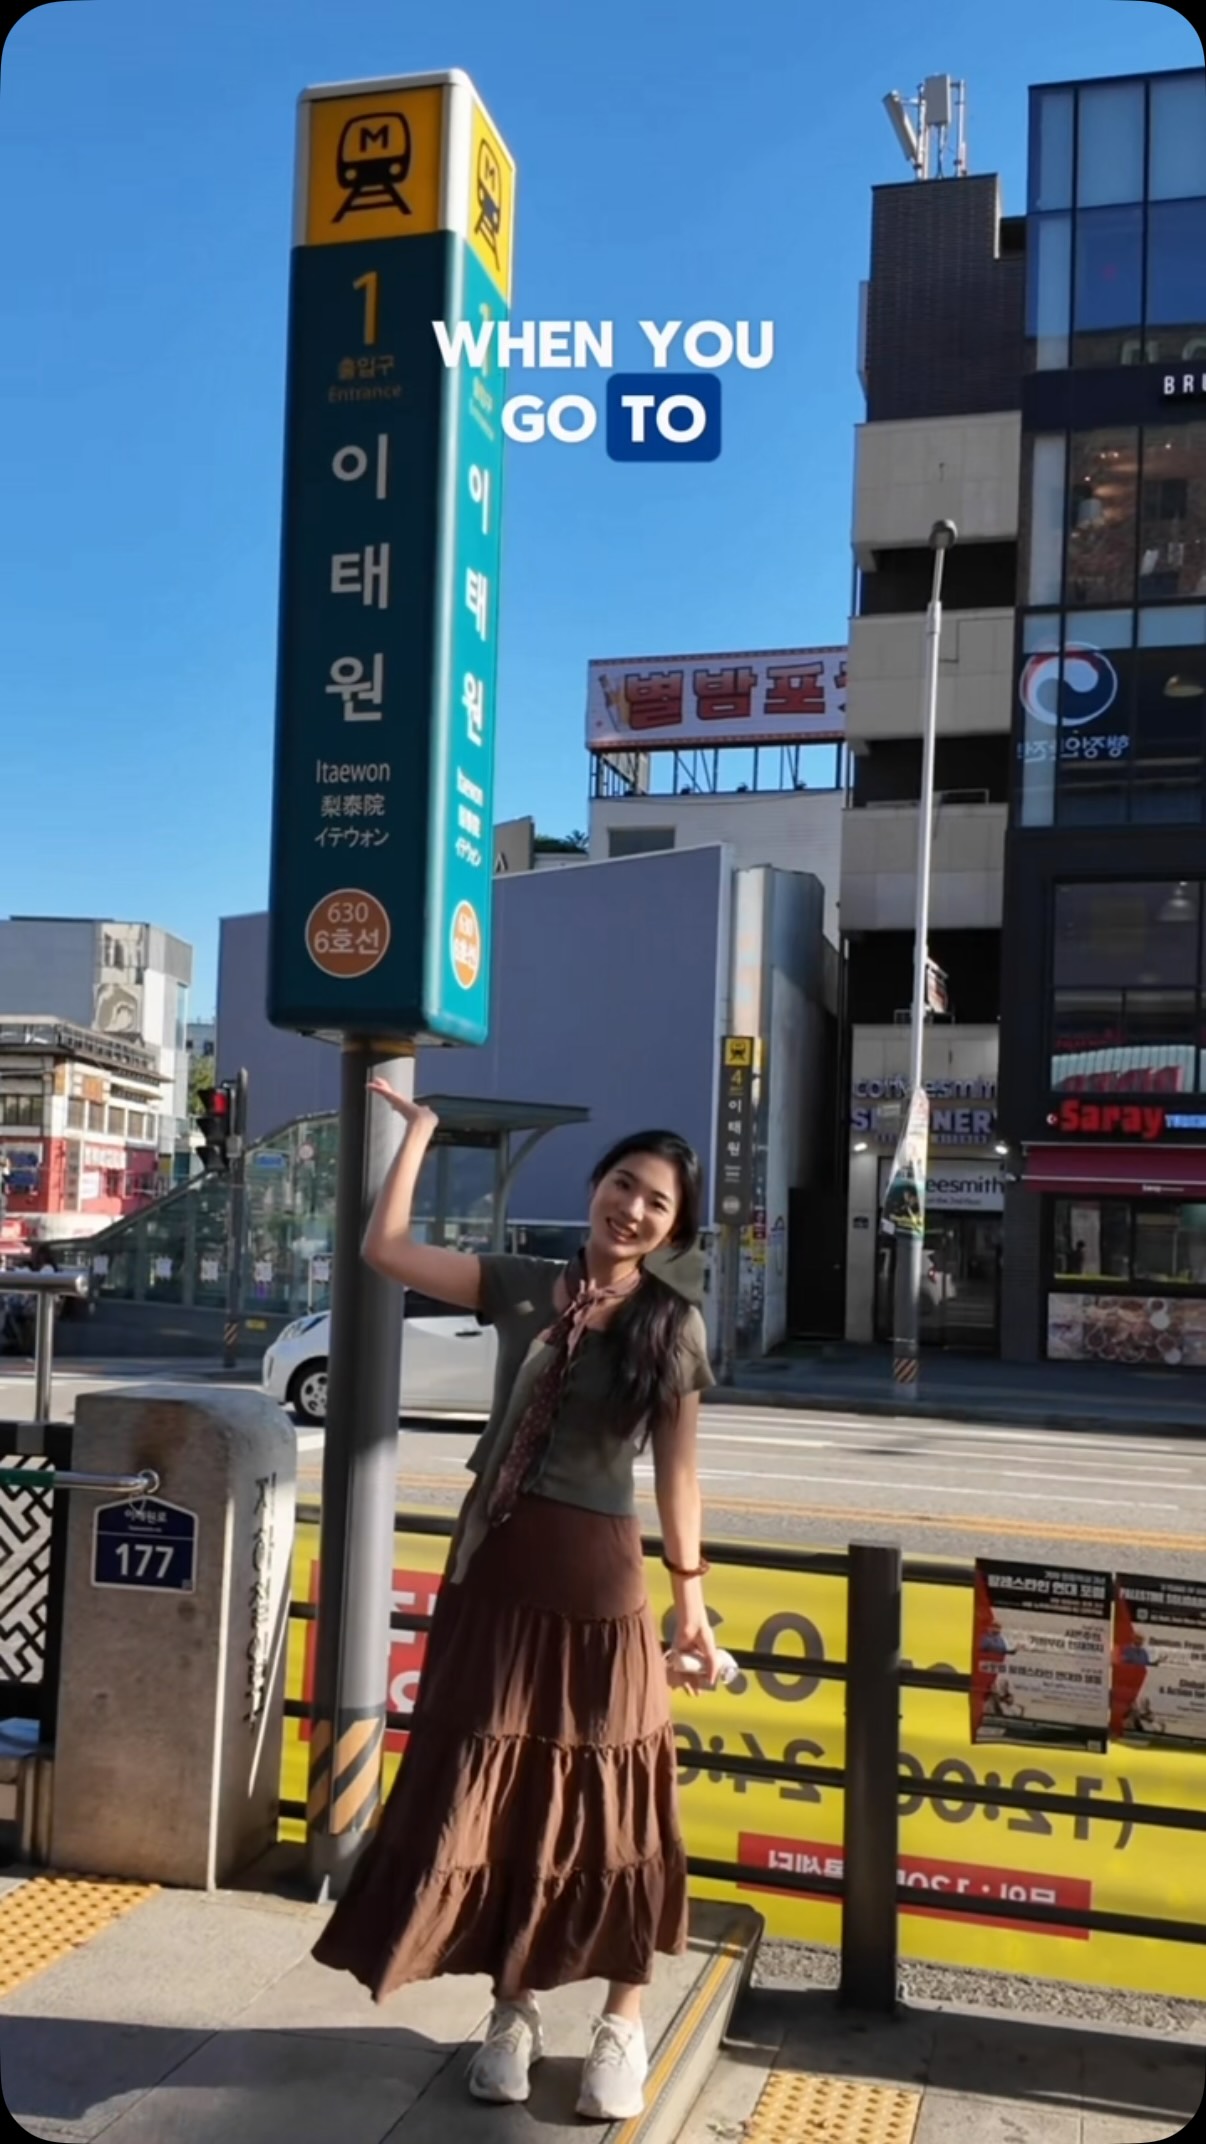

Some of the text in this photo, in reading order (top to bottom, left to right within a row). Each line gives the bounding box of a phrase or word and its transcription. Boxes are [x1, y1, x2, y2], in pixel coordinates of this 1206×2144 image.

[353, 271, 377, 345] 1
[338, 354, 395, 381] 출입구
[327, 384, 403, 404] Entrance
[325, 433, 390, 721] 이태원
[462, 463, 489, 747] 이태원
[625, 661, 848, 730] 별밤포
[316, 759, 391, 783] Itaewon
[320, 793, 385, 817] 梨泰院
[314, 826, 390, 848] イテウォン
[327, 902, 370, 923] 630
[314, 928, 380, 954] 6호선
[1061, 1099, 1164, 1139] Saray
[115, 1543, 174, 1579] 177
